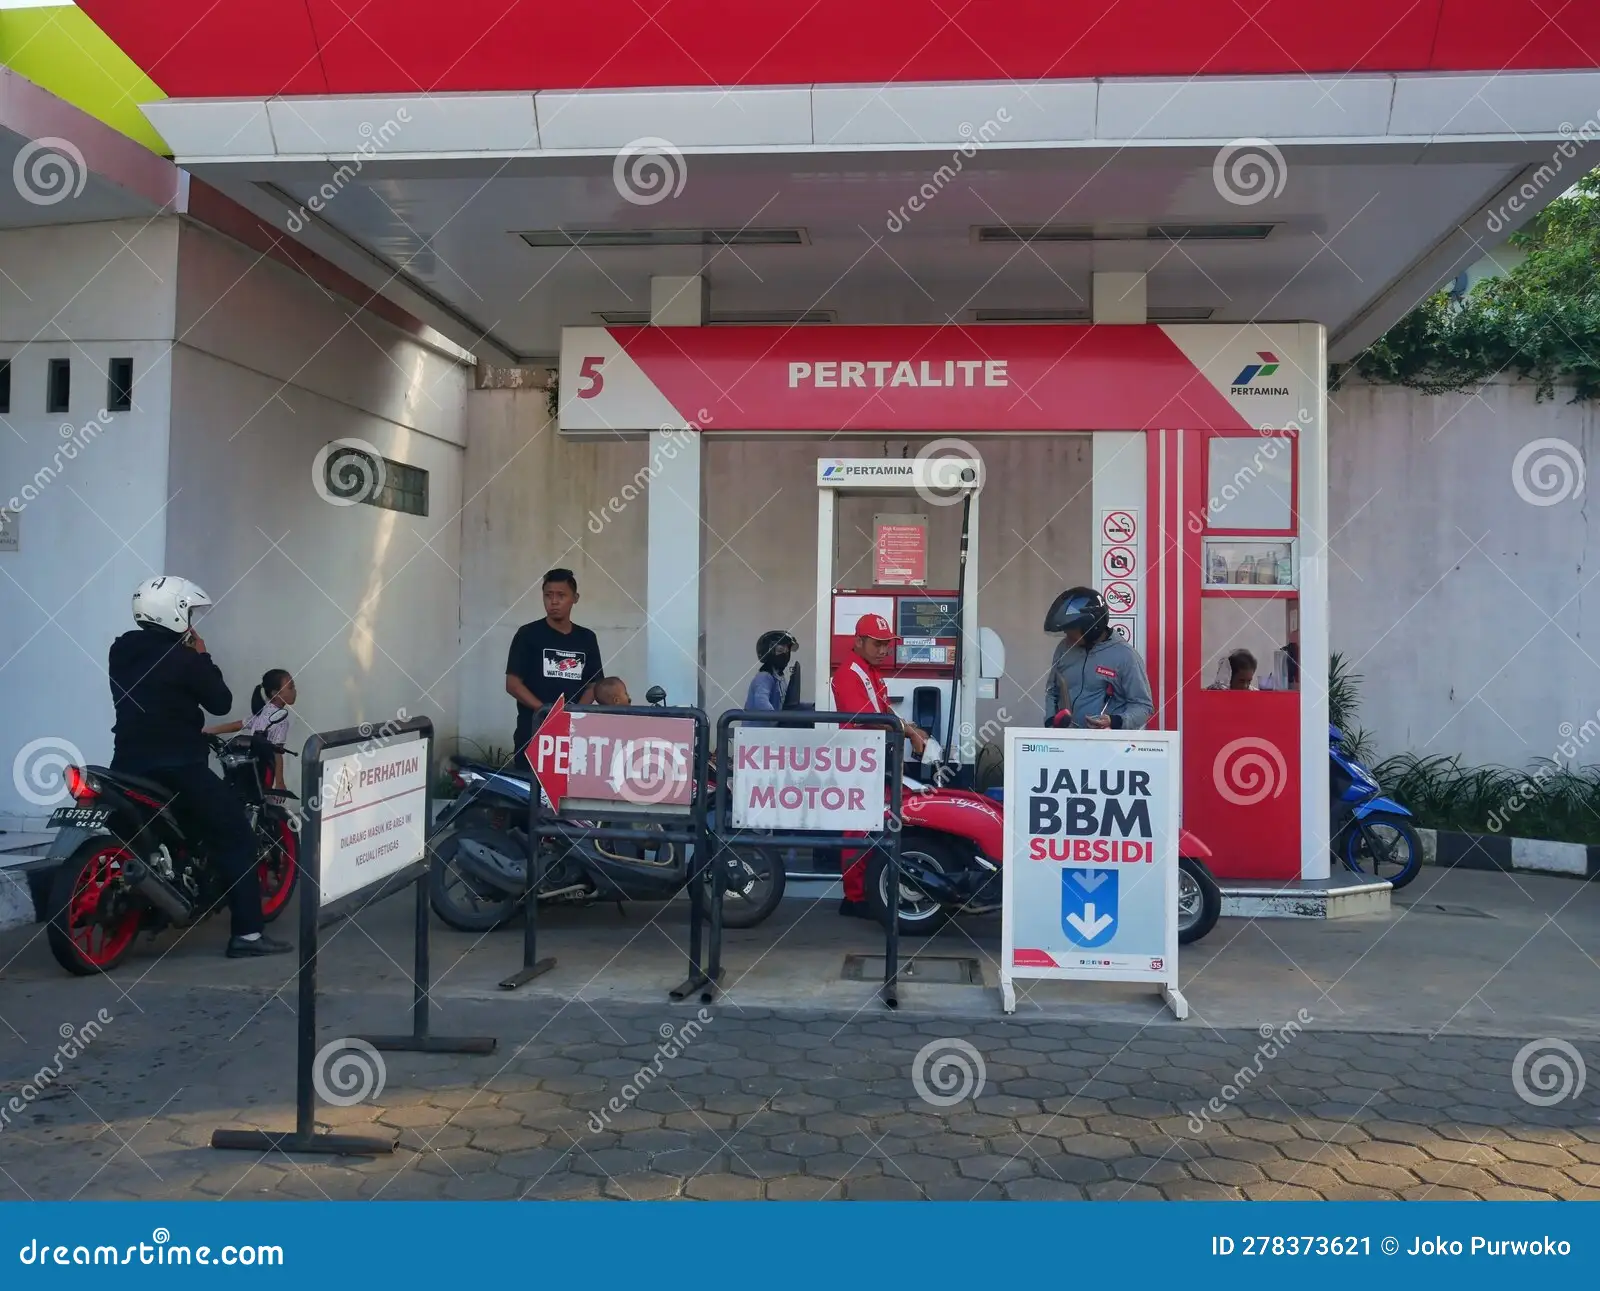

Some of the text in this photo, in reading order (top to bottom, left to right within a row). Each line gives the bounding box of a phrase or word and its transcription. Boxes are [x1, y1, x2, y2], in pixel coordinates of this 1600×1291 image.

[576, 356, 606, 399] 5
[788, 360, 1008, 388] PERTALITE
[1230, 387, 1289, 396] PERTAMINA
[846, 466, 914, 475] PERTAMINA
[359, 757, 419, 788] PERHATIAN
[537, 735, 690, 782] PERTALITE
[738, 745, 877, 773] KHUSUS
[1030, 768, 1152, 796] JALUR
[749, 785, 866, 811] MOTOR
[53, 809, 109, 820] AA 6755 PJ
[1029, 796, 1153, 838] BBM
[340, 830, 367, 849] DILARANG
[368, 823, 385, 838] MASUK
[385, 820, 392, 831] KE
[393, 816, 405, 828] AREA
[378, 839, 399, 857] PETUGAS
[1029, 837, 1153, 863] SUBSIDI
